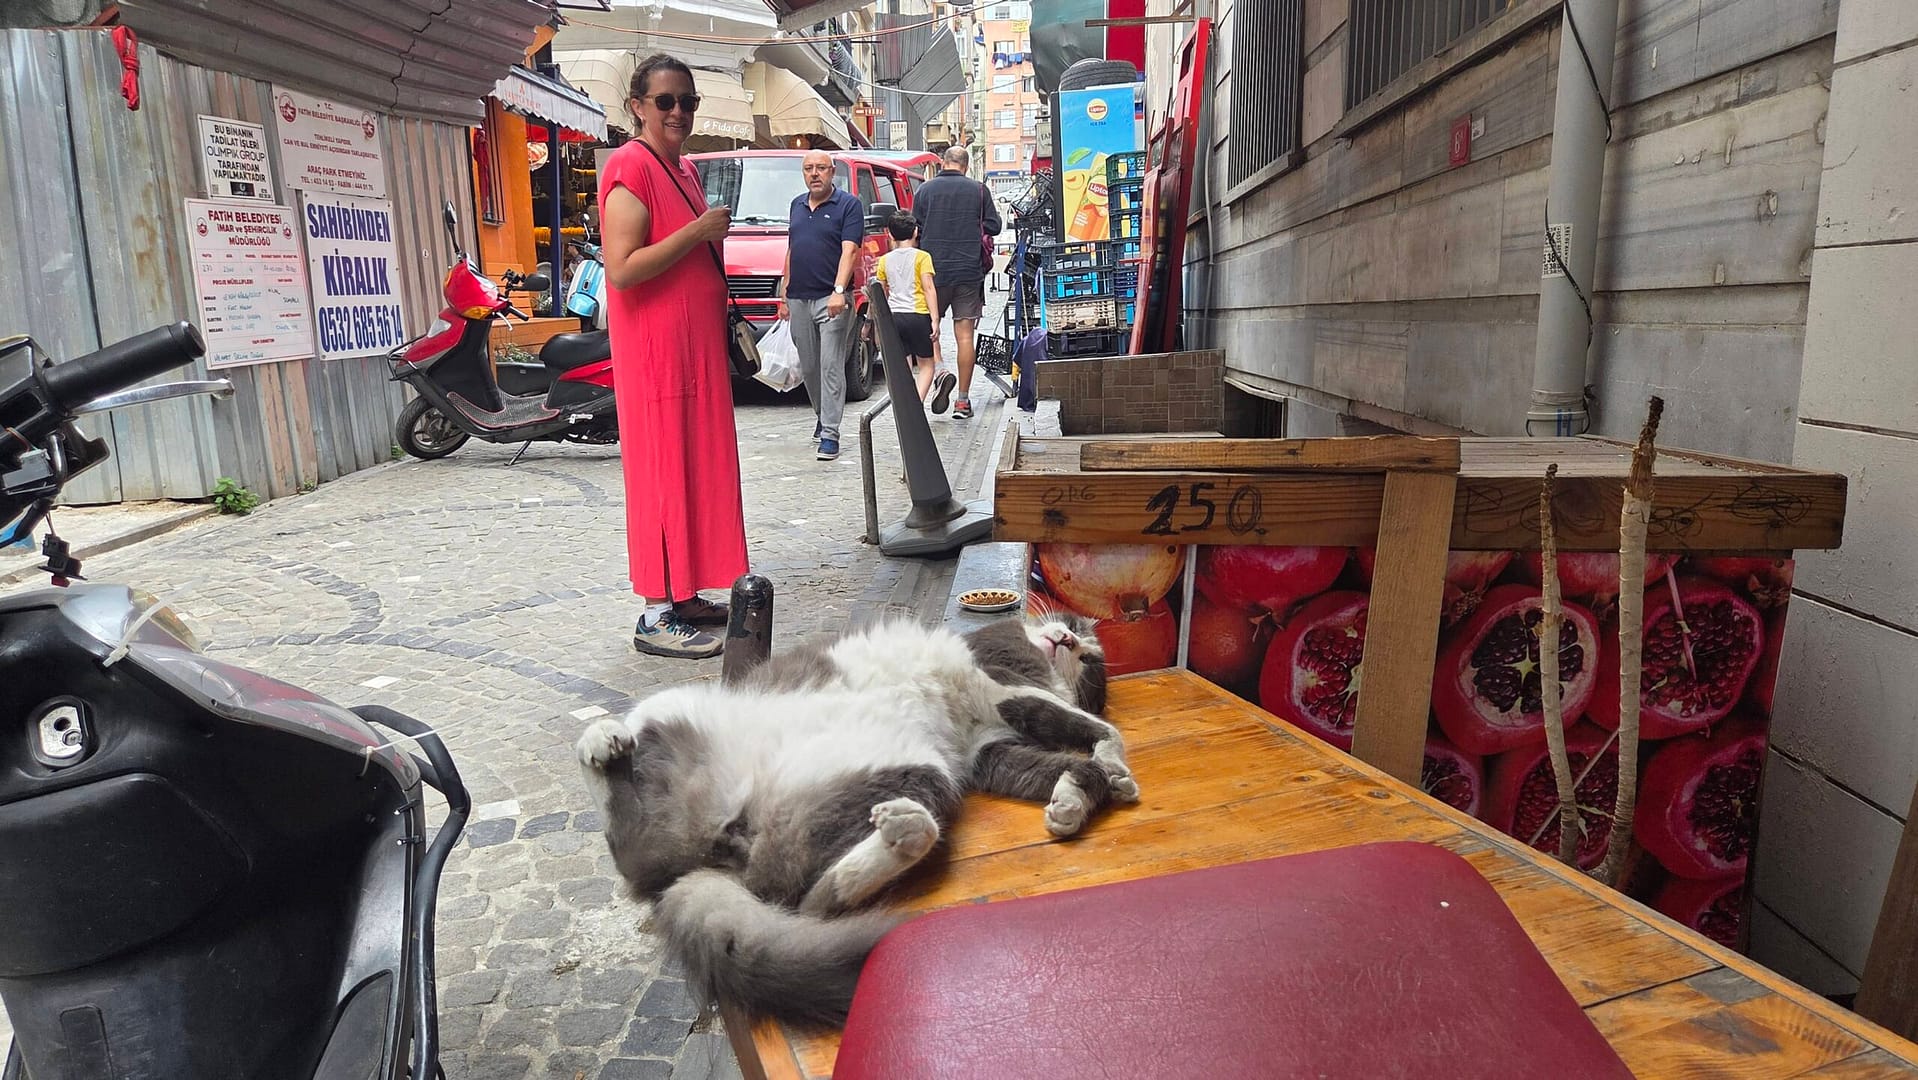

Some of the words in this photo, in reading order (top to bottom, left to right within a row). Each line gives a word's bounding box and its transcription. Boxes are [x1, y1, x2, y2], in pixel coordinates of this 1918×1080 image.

[214, 124, 224, 134] BU
[226, 125, 254, 138] BİNANIN
[210, 134, 238, 147] TADİLAT
[240, 139, 260, 150] İŞLERİ
[240, 150, 265, 162] GROUP
[217, 160, 260, 172] TARAFINDAN
[307, 165, 321, 176] ARAÇ
[322, 167, 337, 177] PARK
[213, 169, 266, 182] YAPILMAKTADIR
[1090, 183, 1108, 195] Lipto
[208, 210, 234, 222] FATİH
[235, 212, 282, 224] BELEDİYESİ
[307, 201, 391, 242] SAHİBİNDEN
[217, 223, 235, 233] İMAR
[244, 224, 277, 235] ŞEHİRCİLİK
[229, 235, 271, 246] MÜDÜRLÜĞÜ
[322, 249, 391, 296] KİRALIK
[318, 306, 353, 352] 0532
[353, 305, 377, 350] 685
[376, 305, 392, 347] 56
[391, 304, 404, 345] 14
